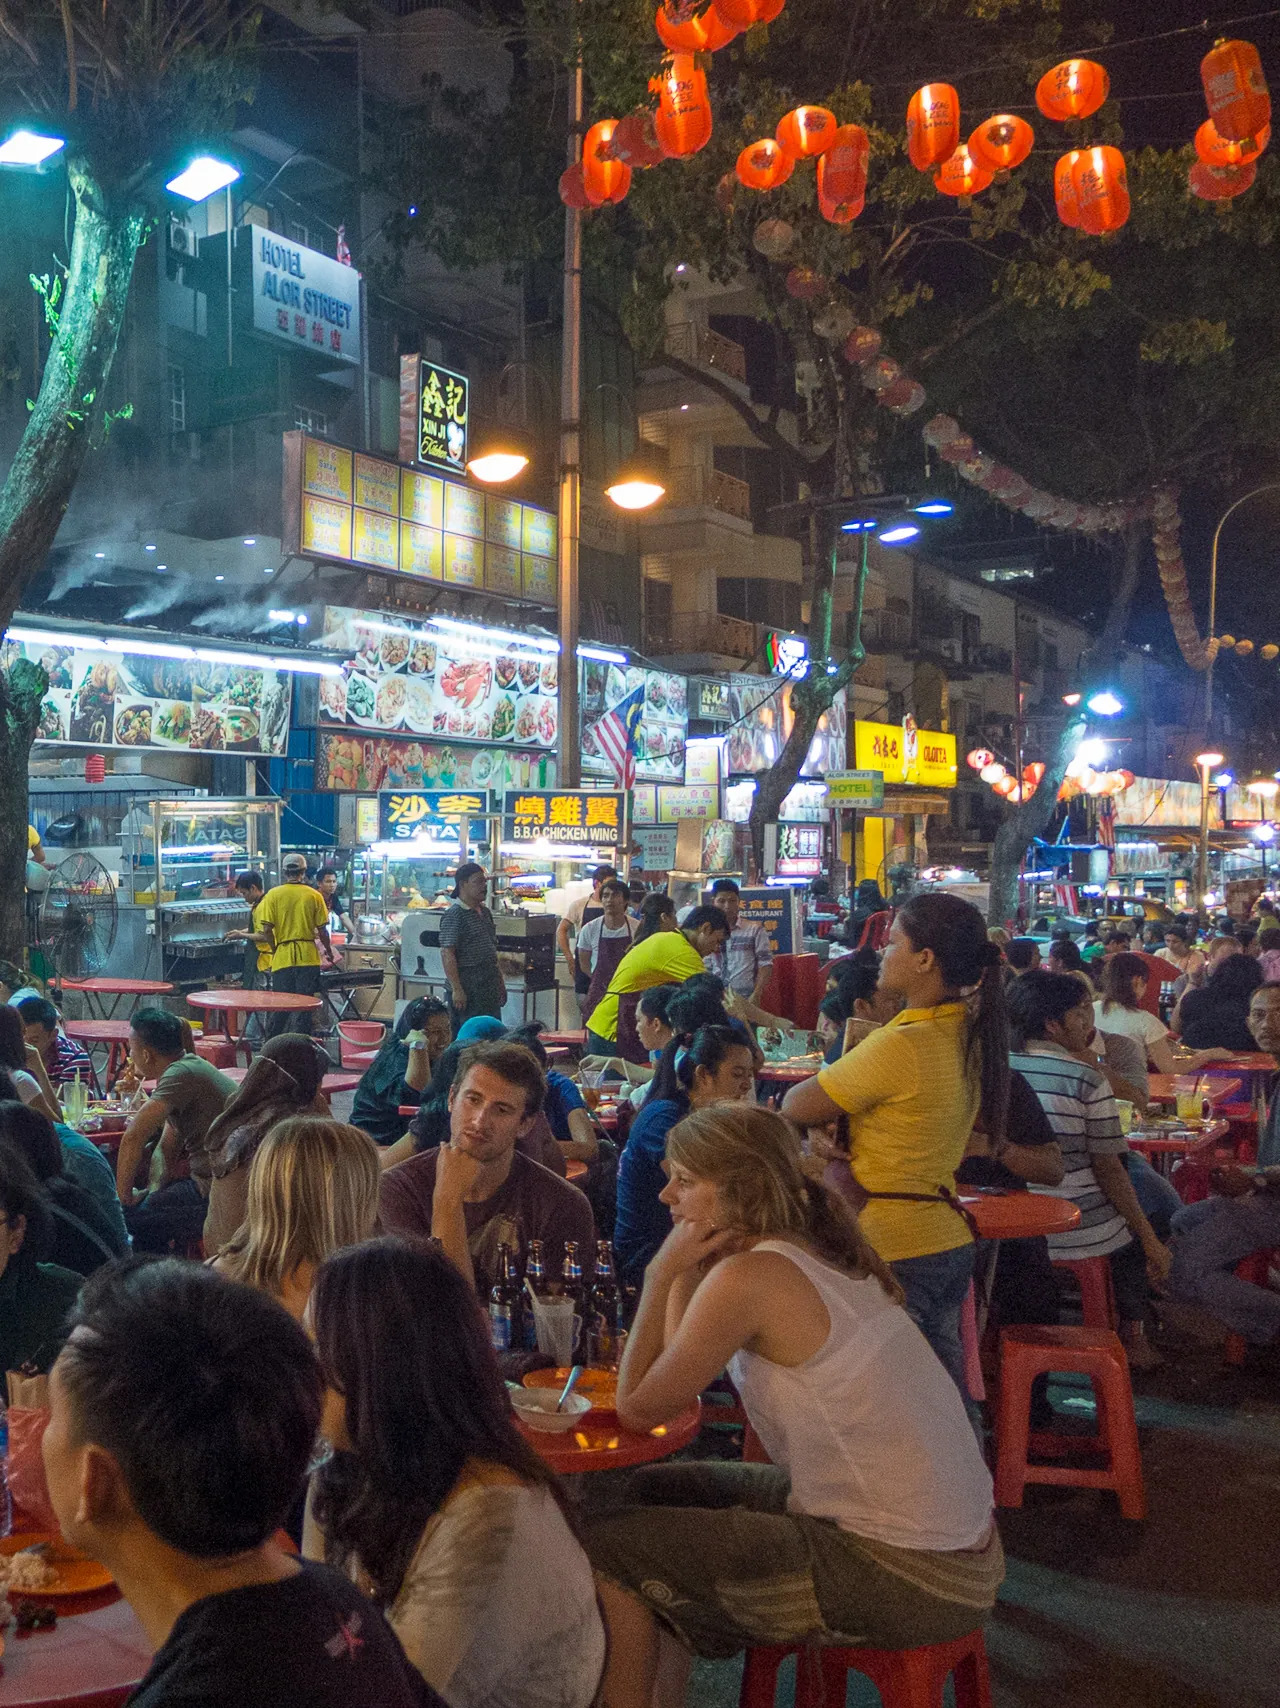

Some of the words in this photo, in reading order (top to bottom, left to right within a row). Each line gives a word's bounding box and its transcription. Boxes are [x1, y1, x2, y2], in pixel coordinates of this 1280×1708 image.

[261, 236, 306, 280] HOTEL
[263, 270, 302, 310] ALOR
[303, 287, 353, 330] STREET
[423, 417, 437, 437] XIN
[438, 424, 446, 439] JI
[830, 783, 870, 793] HOTEL
[543, 827, 589, 841] CHICKEN
[590, 828, 618, 842] WING
[739, 910, 784, 918] RESTAURANT
